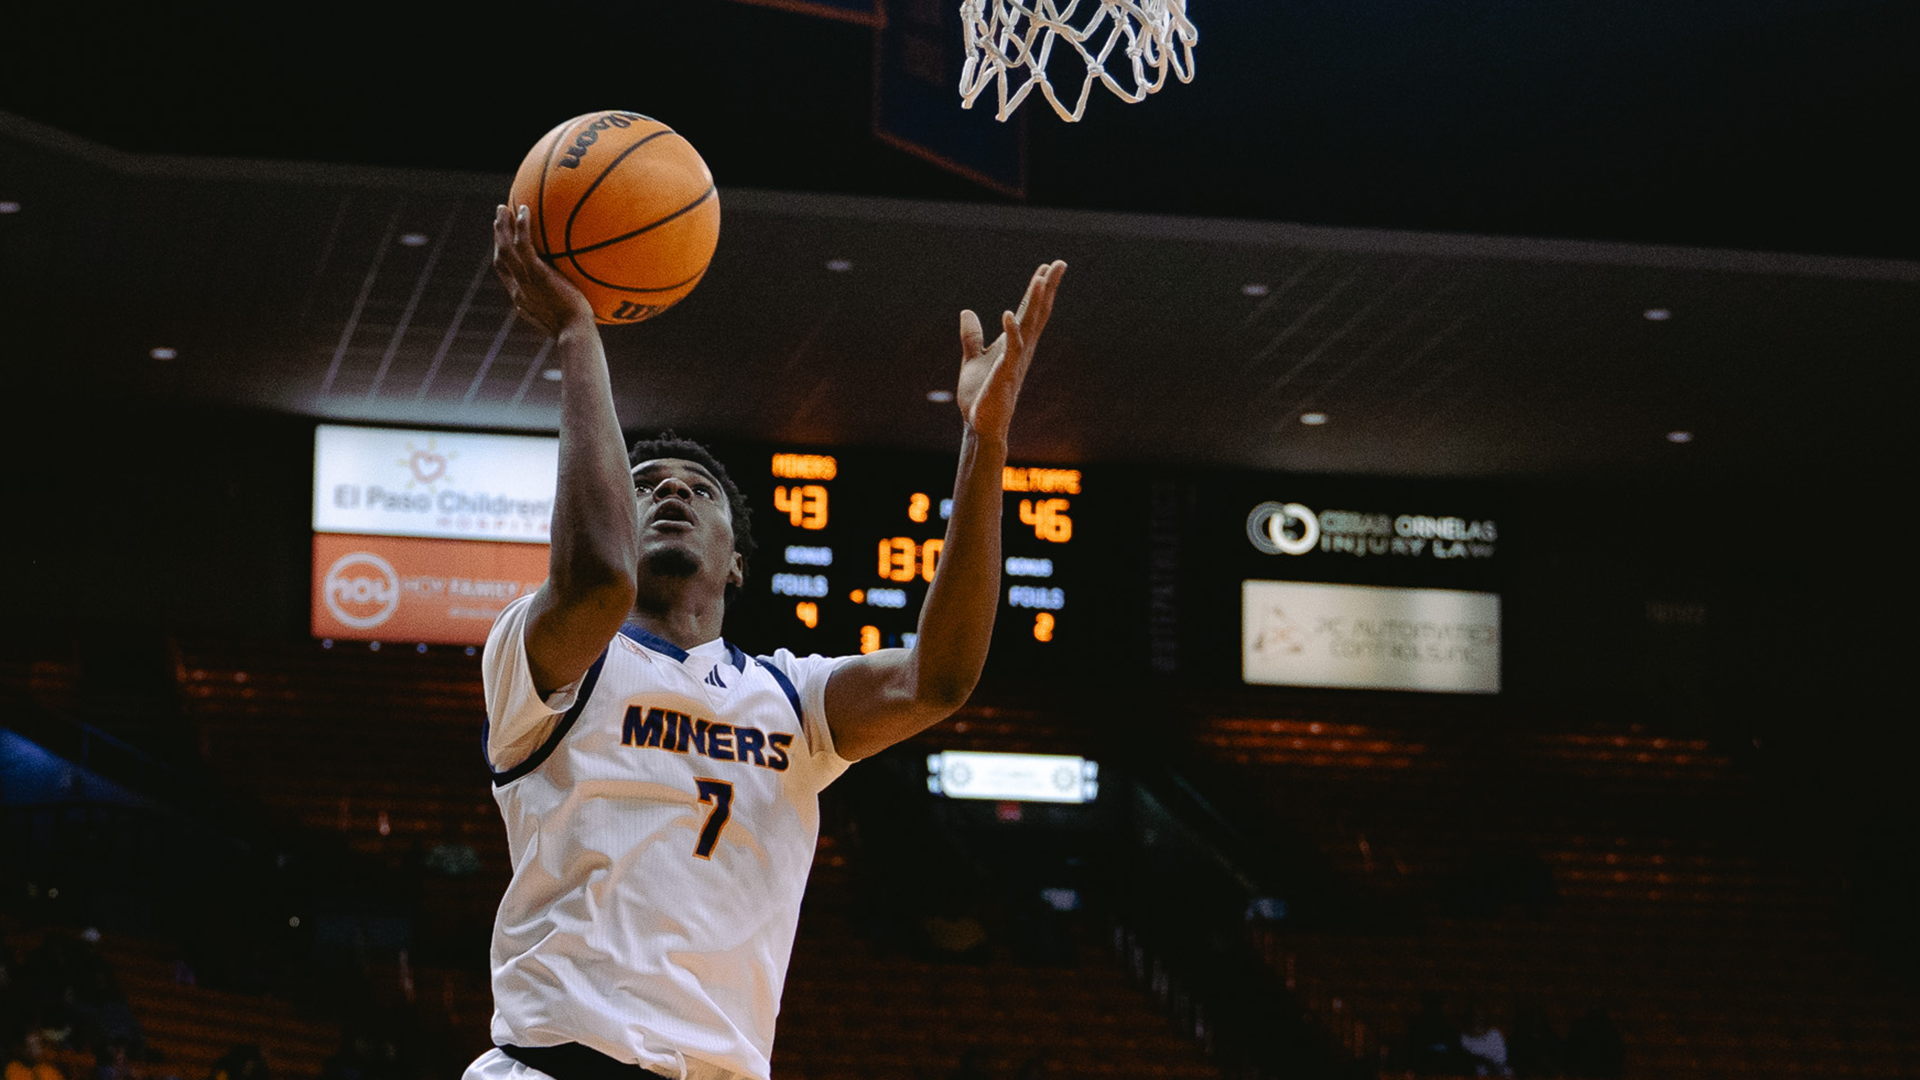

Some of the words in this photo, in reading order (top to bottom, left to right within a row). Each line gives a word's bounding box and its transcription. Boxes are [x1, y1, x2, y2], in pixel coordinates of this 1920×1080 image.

[772, 453, 837, 481] MINERS
[334, 484, 361, 510] El
[366, 485, 433, 514] Paso
[774, 485, 828, 530] 43
[908, 492, 930, 523] 2
[1019, 498, 1073, 544] 46
[1395, 514, 1498, 543] ORNELAS
[1319, 535, 1425, 557] INJURY
[1431, 540, 1496, 559] LAW
[771, 573, 829, 598] FOULS
[1008, 585, 1065, 610] FOULS
[796, 601, 818, 629] 4
[1033, 612, 1055, 642] 2
[859, 624, 880, 655] 3
[621, 704, 794, 773] MINERS
[692, 776, 734, 861] 7
